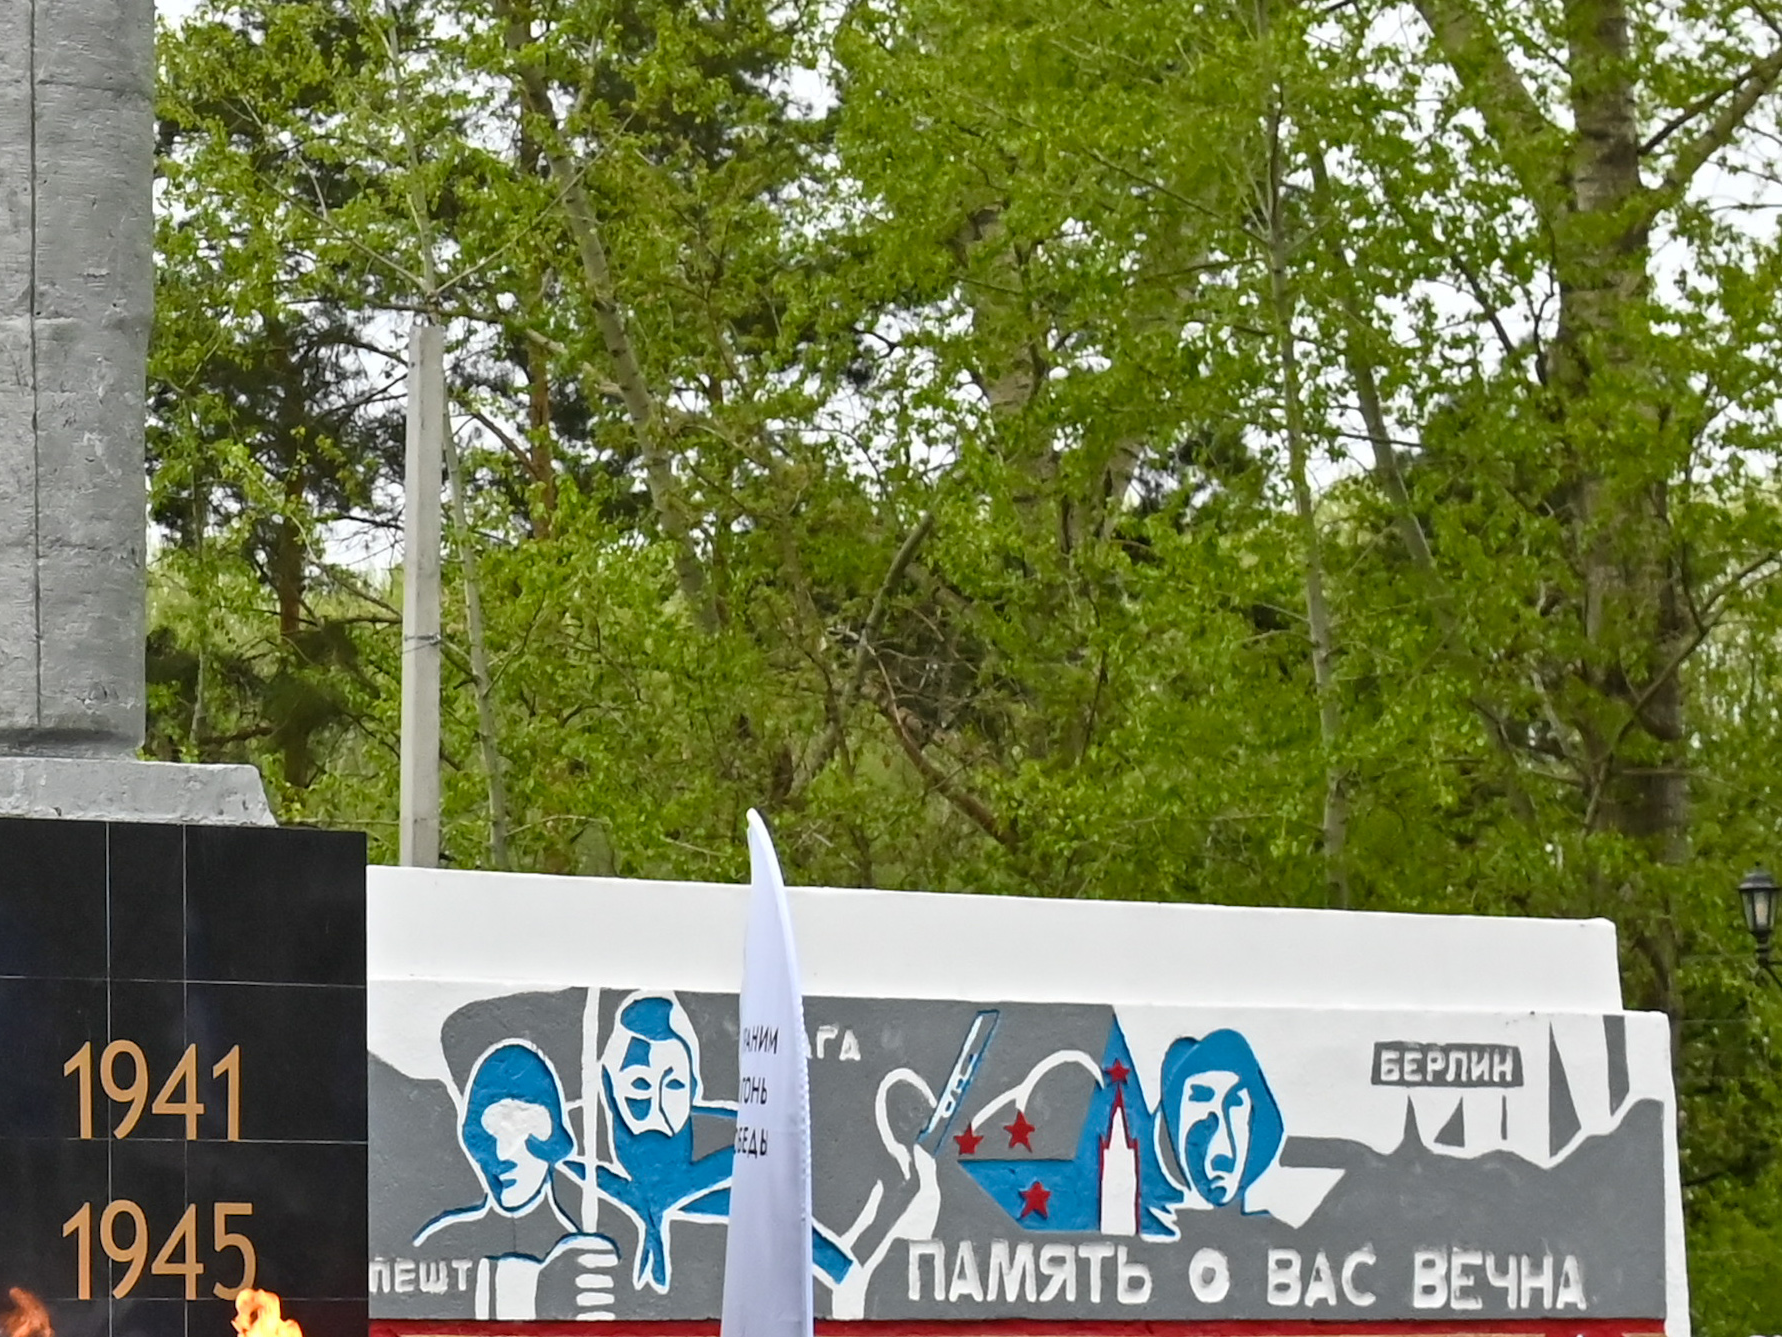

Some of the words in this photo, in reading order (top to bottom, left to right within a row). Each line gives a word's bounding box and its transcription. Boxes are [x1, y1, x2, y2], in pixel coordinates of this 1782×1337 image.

[808, 1025, 862, 1061] ГА
[1380, 1048, 1514, 1083] БЕРЛИН
[63, 1039, 240, 1142] 1941
[62, 1199, 257, 1301] 1945
[908, 1238, 1153, 1305] ПАМЯТЬ
[1188, 1247, 1231, 1305] О
[1267, 1245, 1378, 1308] ВАС
[1411, 1247, 1588, 1311] ВЕЧНА
